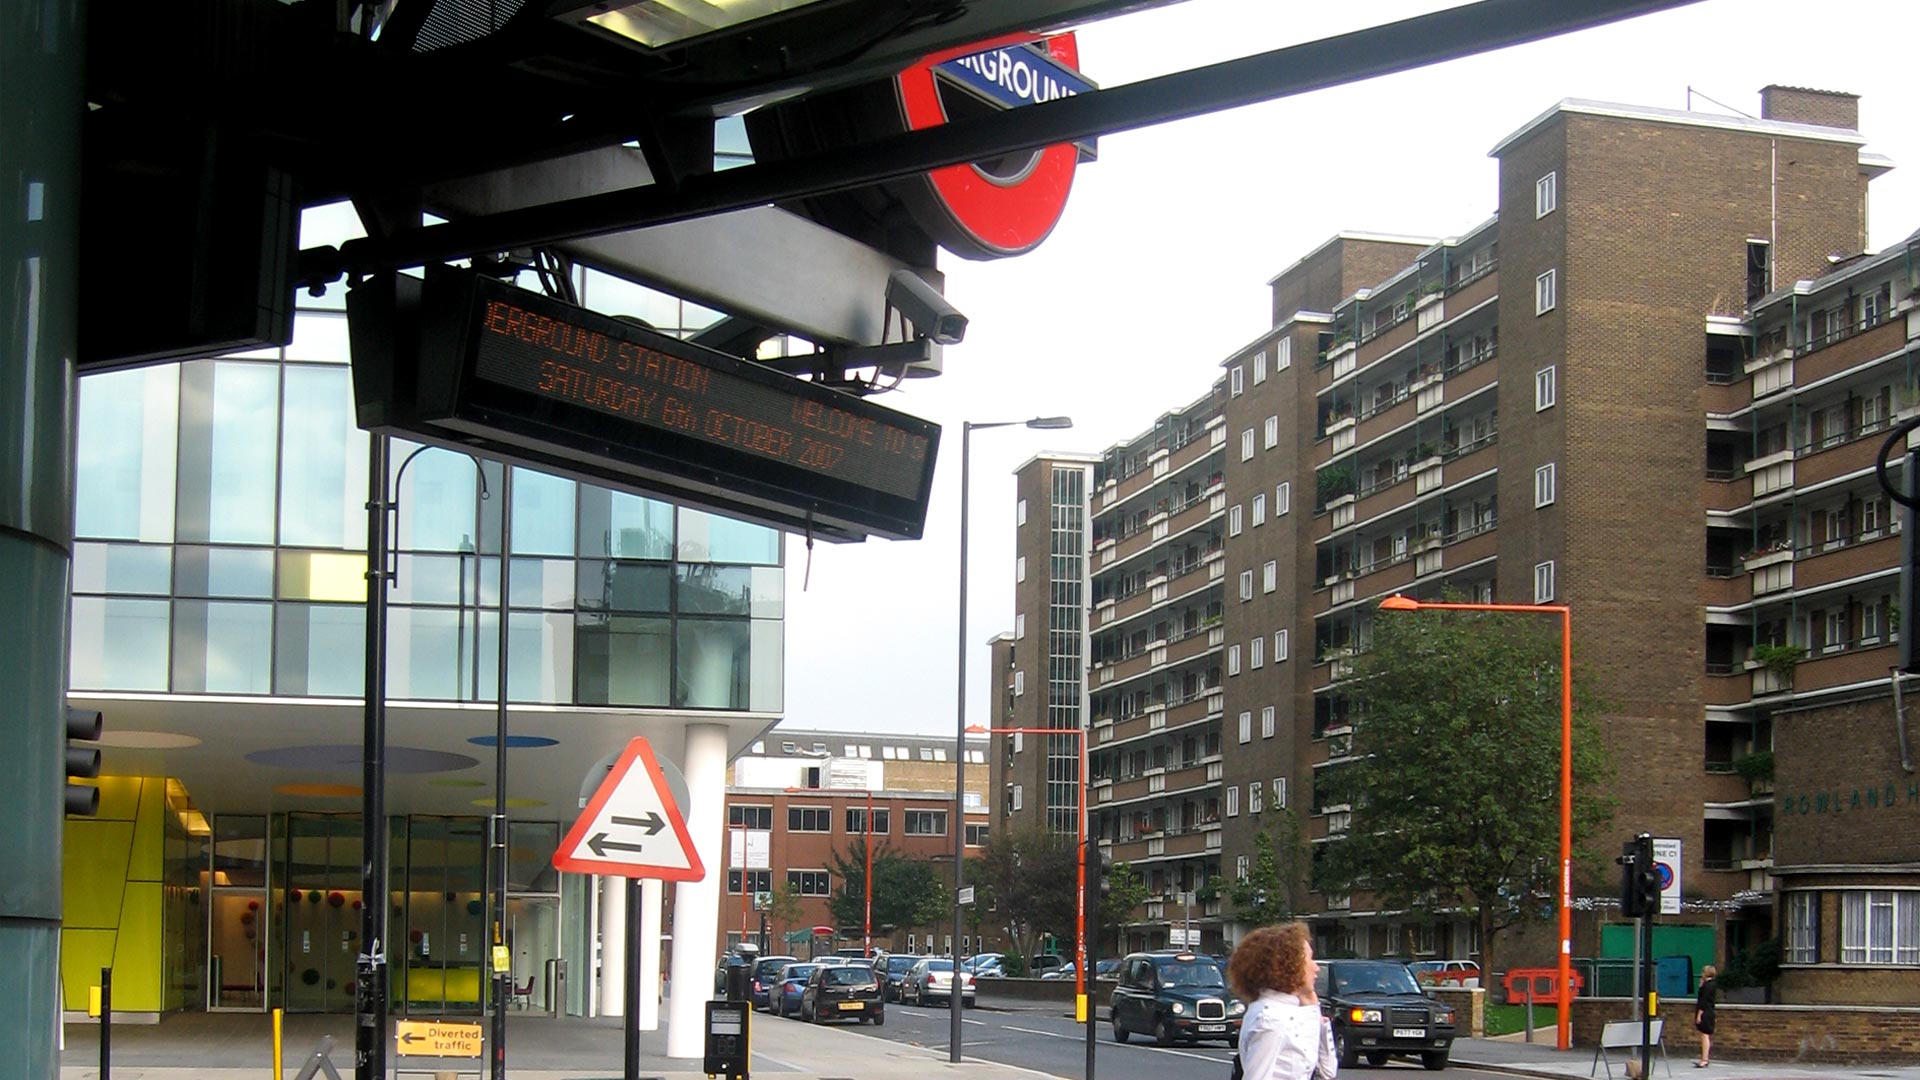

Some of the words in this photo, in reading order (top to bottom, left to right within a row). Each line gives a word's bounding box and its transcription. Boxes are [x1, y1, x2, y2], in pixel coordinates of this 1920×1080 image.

[616, 341, 710, 395] STATION
[792, 397, 876, 446] WELCOME
[885, 423, 906, 455] TO
[538, 361, 656, 419] SATURDAY
[662, 397, 697, 432] 6th
[703, 407, 792, 458] OCTOBER
[798, 436, 844, 469] 2007
[1783, 782, 1895, 815] ROWLAND
[428, 1028, 479, 1039] Diverted
[434, 1041, 471, 1050] traffic
